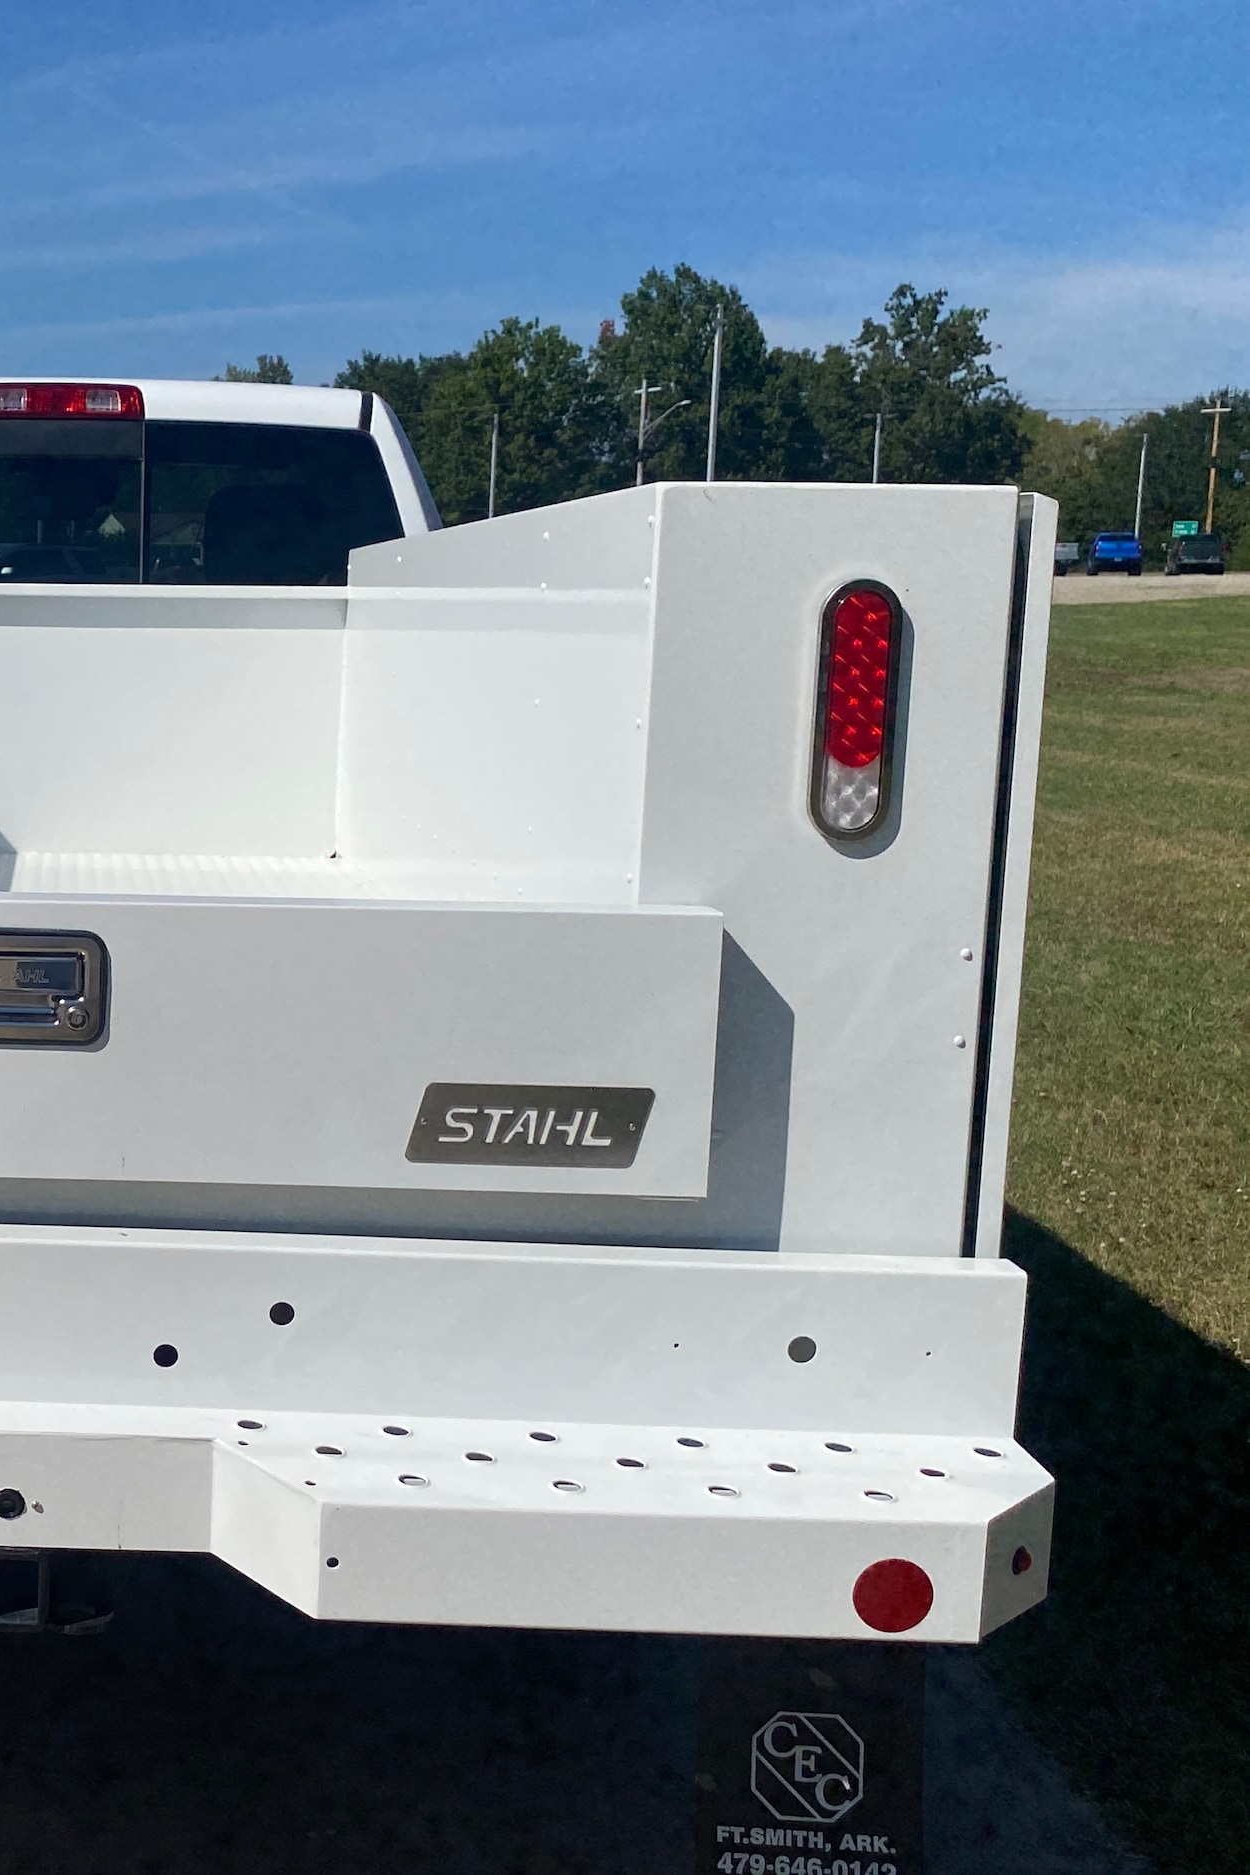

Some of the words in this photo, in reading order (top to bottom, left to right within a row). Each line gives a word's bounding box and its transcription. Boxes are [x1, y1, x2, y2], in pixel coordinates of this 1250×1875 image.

[437, 1106, 613, 1147] STAHL
[763, 1721, 852, 1811] CEC
[716, 1825, 832, 1852] FT.SMITH,
[839, 1833, 897, 1854] ARK.
[716, 1851, 898, 1875] 479-646-0142
